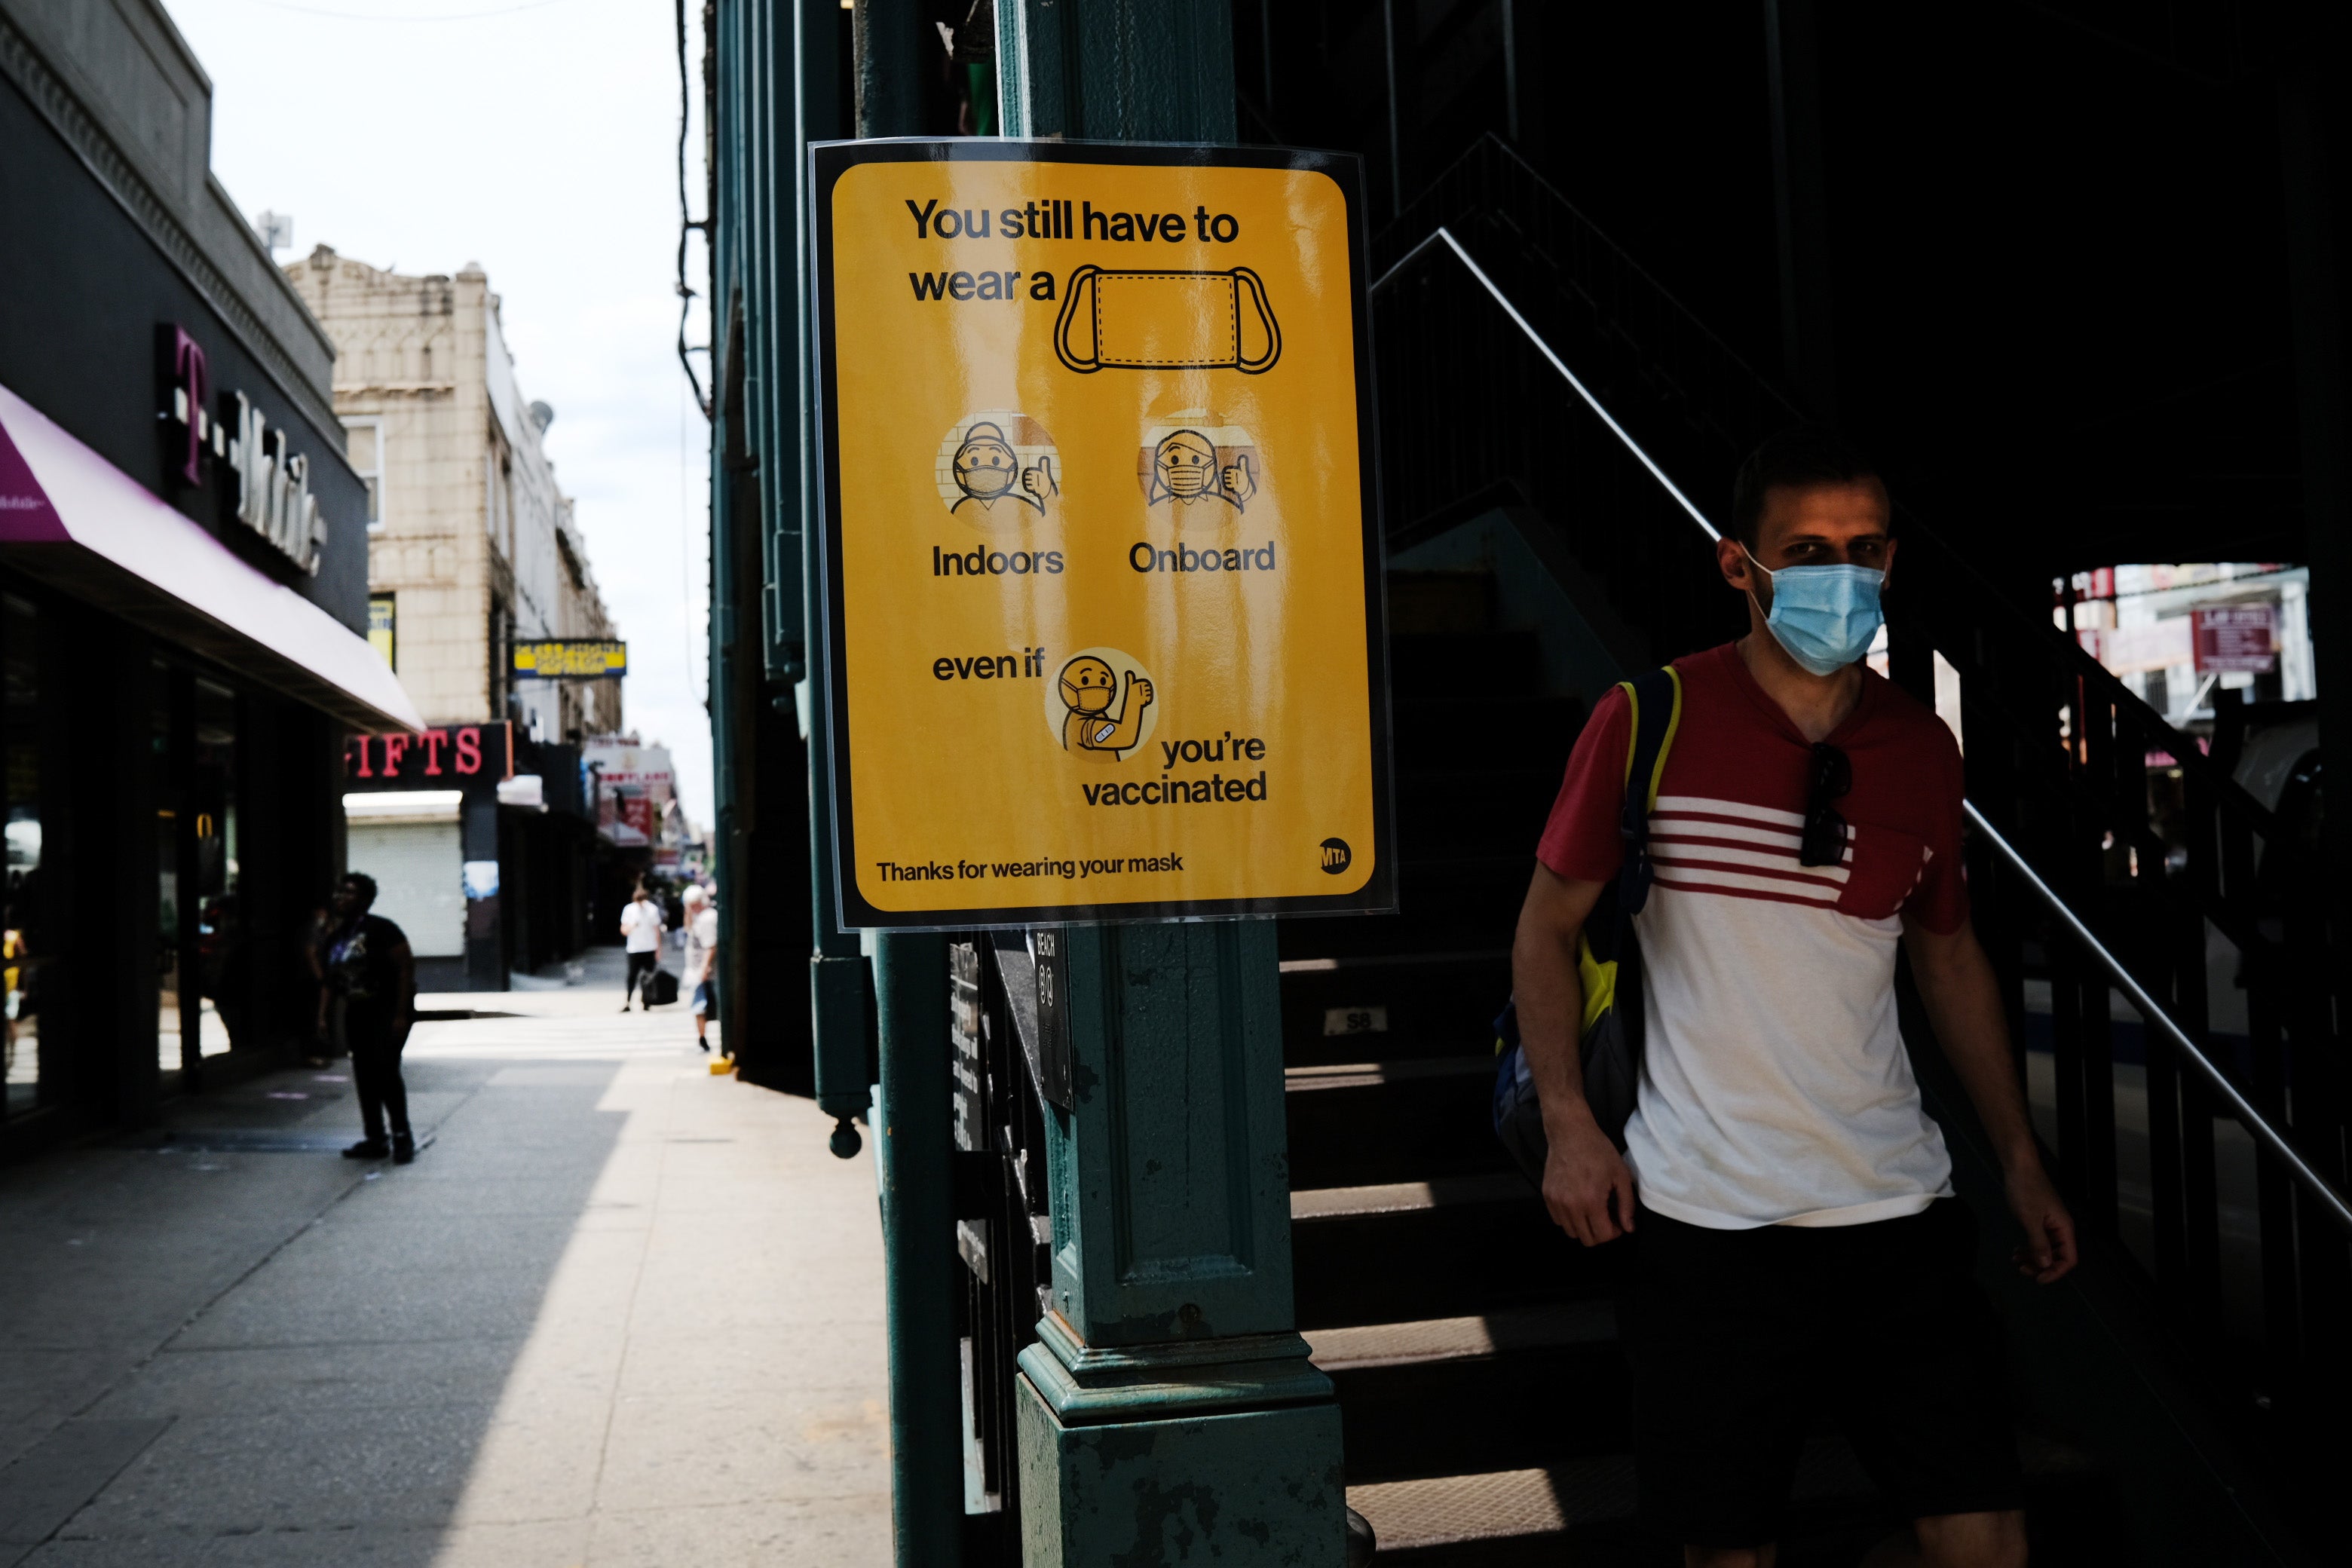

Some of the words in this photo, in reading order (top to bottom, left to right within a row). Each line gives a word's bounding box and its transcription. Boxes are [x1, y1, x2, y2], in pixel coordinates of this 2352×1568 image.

[905, 198, 991, 240] You
[1000, 199, 1073, 240] still
[1082, 201, 1187, 243] have
[1193, 205, 1239, 243] to
[908, 271, 1021, 302] wear
[1029, 271, 1056, 301] a
[933, 544, 1064, 577] Indoors
[1129, 541, 1276, 574] Onboard
[933, 655, 1018, 681] even
[1024, 647, 1046, 678] if
[345, 727, 482, 777] IFTS
[1160, 730, 1266, 770] you’re
[1081, 770, 1267, 807] vaccinated
[876, 860, 954, 882] Thanks
[957, 859, 988, 880] for
[991, 856, 1076, 880] wearing
[1079, 858, 1125, 879] your
[1128, 852, 1184, 873] mask
[1319, 844, 1347, 870] MTA
[1037, 933, 1055, 957] BEACH
